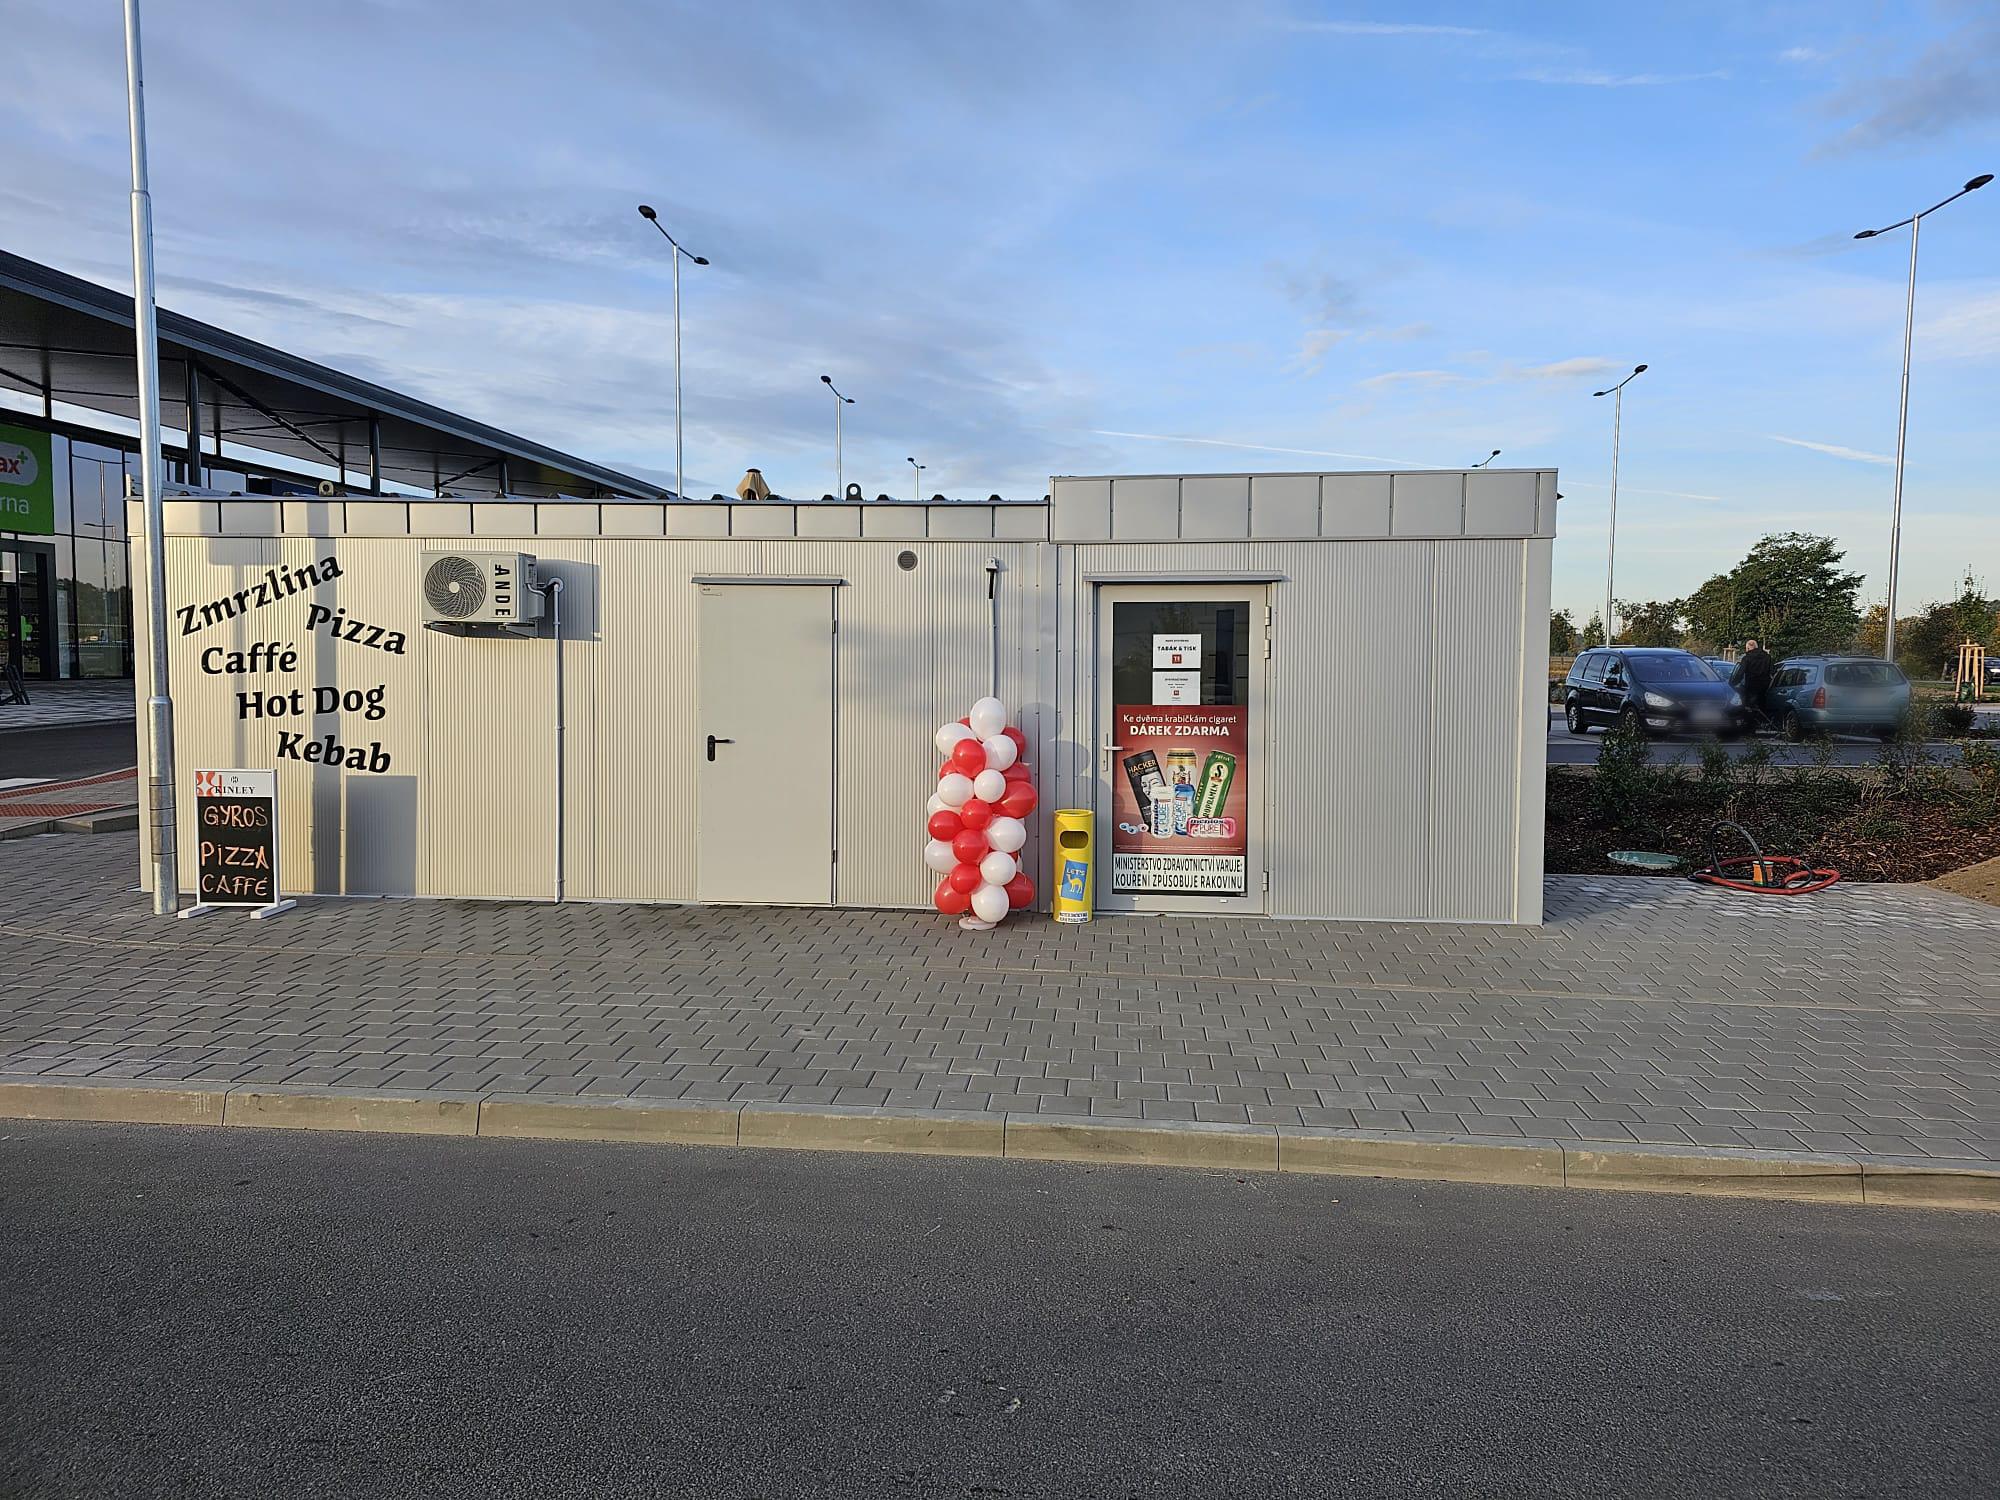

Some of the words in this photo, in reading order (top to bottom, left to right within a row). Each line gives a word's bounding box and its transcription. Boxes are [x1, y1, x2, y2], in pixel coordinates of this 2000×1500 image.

[176, 555, 344, 636] Zmrzlina
[494, 564, 511, 616] ANDE
[305, 603, 406, 655] Pizza
[201, 641, 297, 675] Caffé
[236, 689, 304, 720] Hot
[312, 684, 386, 721] Dog
[1123, 714, 1134, 723] Ke
[1135, 714, 1163, 723] dvěma
[1165, 714, 1207, 723] krabičkám
[1208, 714, 1237, 725] cigaret
[1129, 724, 1172, 736] DÁREK
[1174, 725, 1230, 736] ZDARMA
[277, 730, 391, 774] Kebab
[1128, 759, 1157, 774] HACKER
[214, 785, 256, 794] KINLEY
[203, 805, 268, 828] GYROS
[1114, 856, 1162, 870] MINISTERSTVO
[1163, 856, 1215, 872] ZDRAVOTNICTVÍ
[1215, 859, 1243, 873] VARUJE:
[201, 874, 269, 896] CAFFÉ
[1115, 871, 1151, 887] KOUŘENÍ
[1152, 871, 1198, 888] ZPŮSOBUJE
[1200, 875, 1242, 889] RAKOVINU
